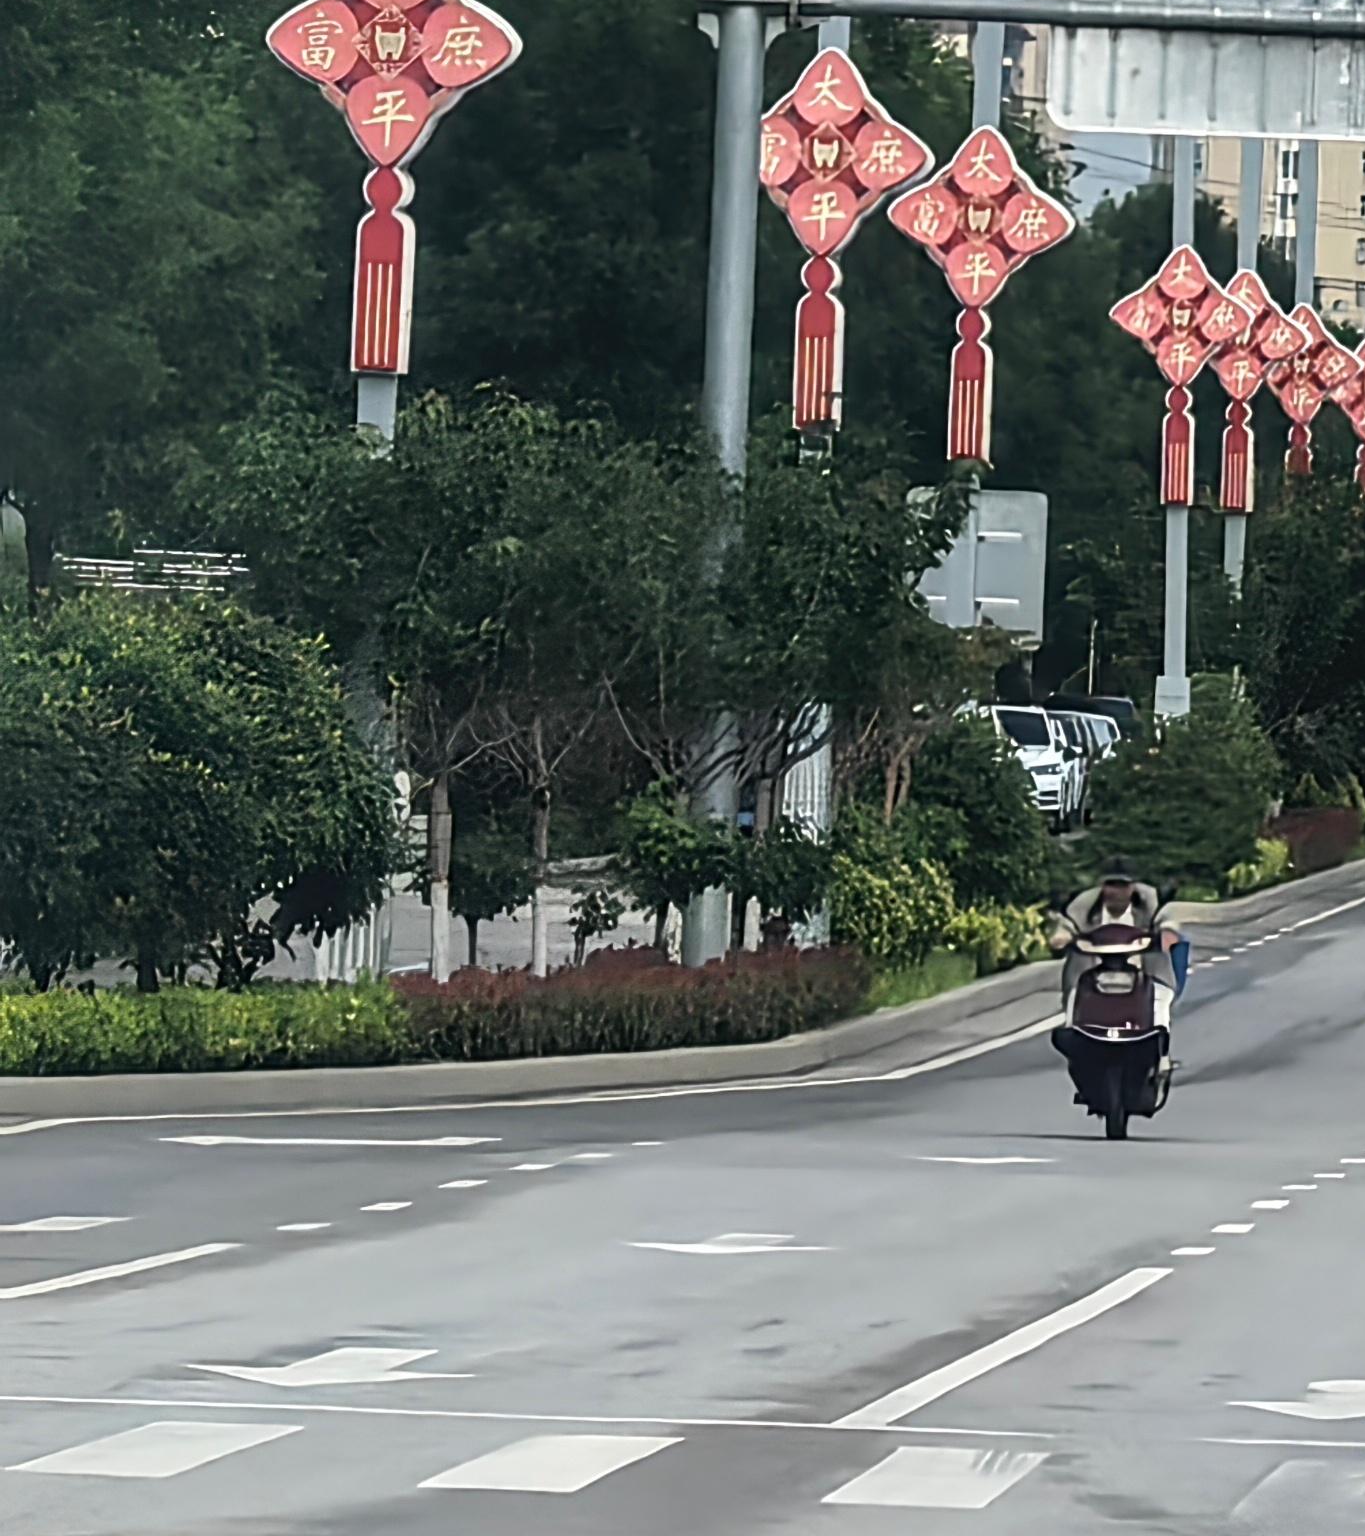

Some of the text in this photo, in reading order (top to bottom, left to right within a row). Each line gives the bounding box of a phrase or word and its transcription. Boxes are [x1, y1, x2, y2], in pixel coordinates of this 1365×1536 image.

[296, 13, 487, 71] 富 庶
[806, 64, 854, 111] 太
[361, 90, 416, 147] 平
[861, 130, 905, 175] 庶
[966, 139, 1001, 182] 太
[802, 191, 846, 241] 平
[912, 193, 1050, 241] 富 庶
[958, 253, 996, 295] 平
[1163, 343, 1197, 380] 平
